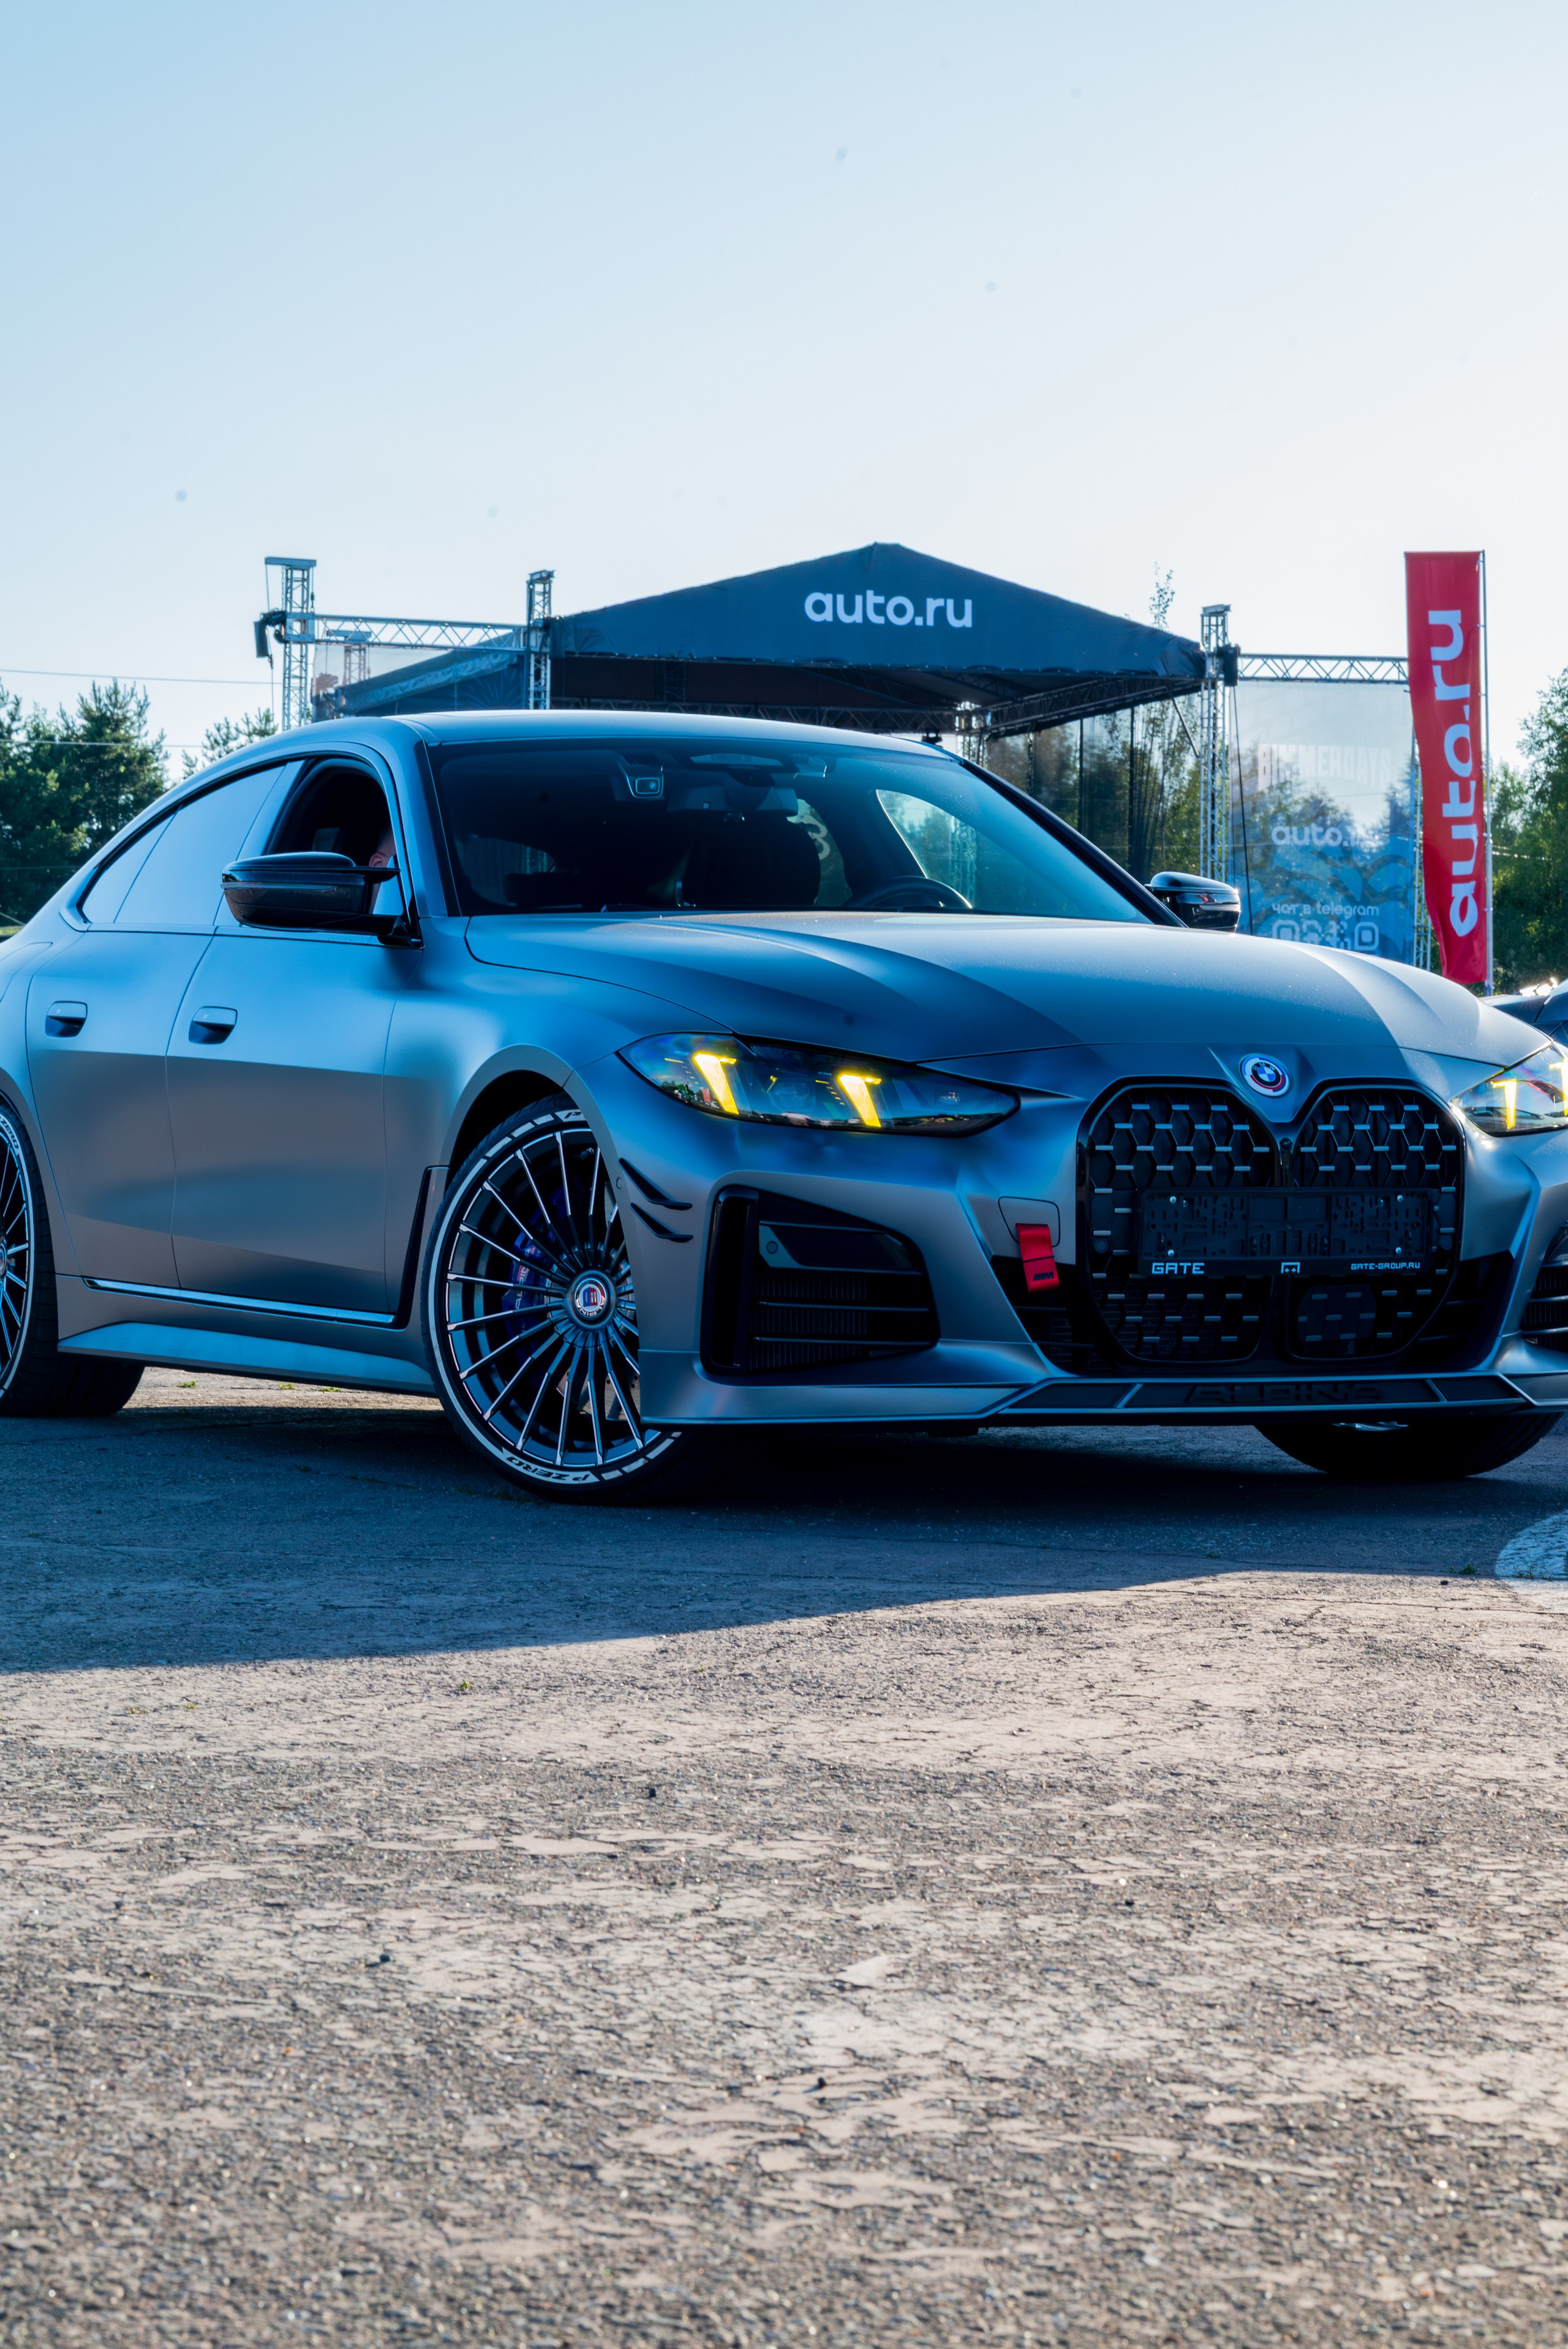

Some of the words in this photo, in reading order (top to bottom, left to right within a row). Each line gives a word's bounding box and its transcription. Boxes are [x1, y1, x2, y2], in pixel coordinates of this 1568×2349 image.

[804, 589, 973, 628] auto.ru
[1428, 609, 1479, 937] auto.ru
[1316, 901, 1379, 919] telegram
[1253, 1062, 1276, 1071] BMW
[1152, 1262, 1205, 1274] GATE
[1351, 1262, 1420, 1270] GATE-GROUP.RU
[1184, 1382, 1387, 1403] ALPINA
